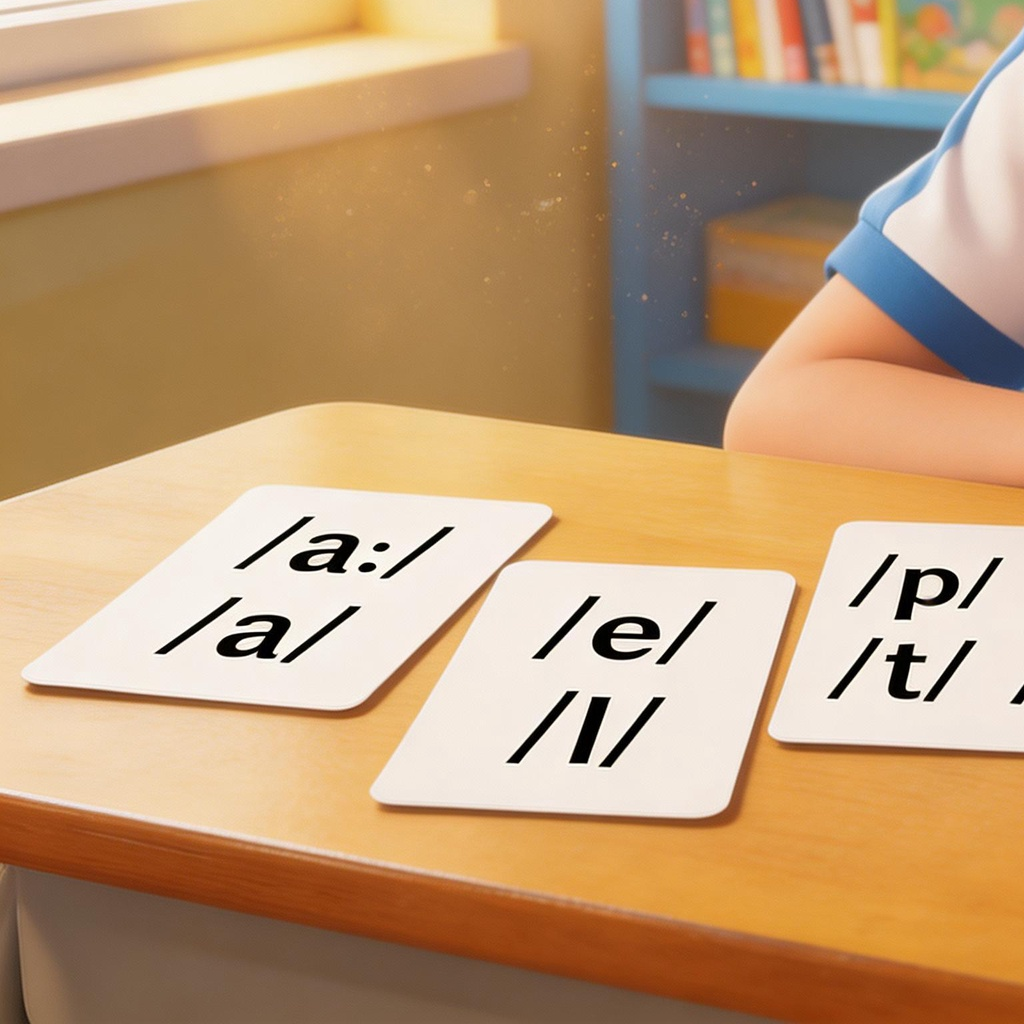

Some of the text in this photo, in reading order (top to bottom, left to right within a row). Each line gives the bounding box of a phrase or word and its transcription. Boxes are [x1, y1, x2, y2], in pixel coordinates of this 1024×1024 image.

[848, 554, 1004, 621] /p/
[155, 597, 361, 664] /a/
[532, 595, 717, 665] /e/
[827, 637, 977, 702] /t/
